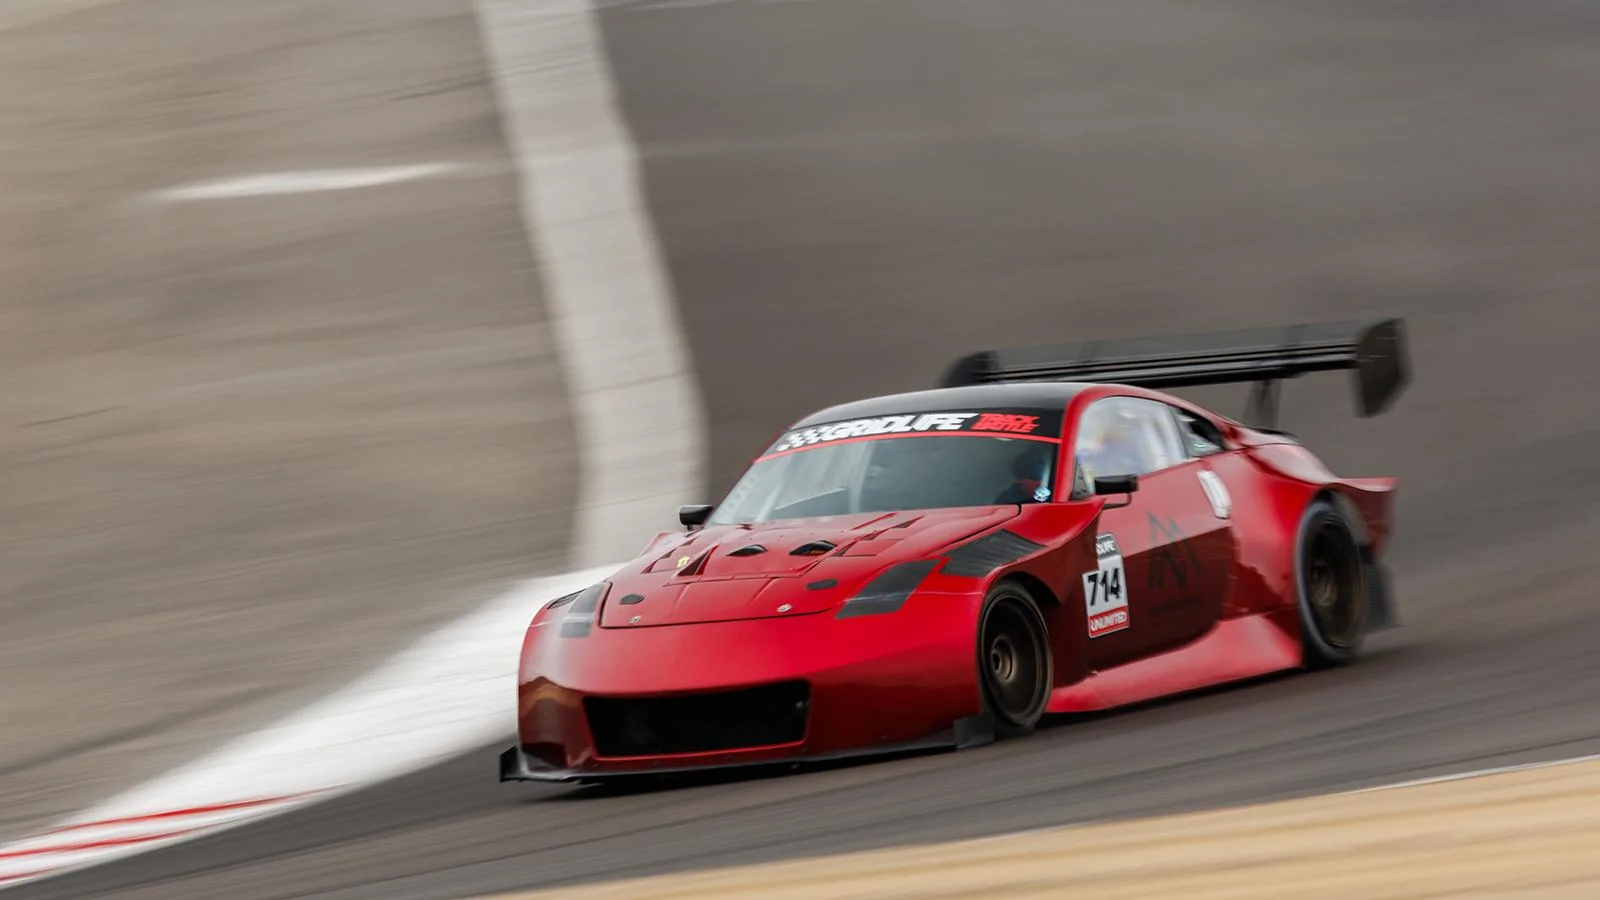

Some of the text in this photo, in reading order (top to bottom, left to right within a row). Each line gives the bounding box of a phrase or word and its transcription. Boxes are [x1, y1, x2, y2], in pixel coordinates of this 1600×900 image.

[819, 413, 978, 441] GRIDLIFE
[971, 421, 1039, 433] BATTLE
[977, 413, 1040, 424] TRACK
[1088, 568, 1121, 606] 714
[1090, 611, 1127, 631] UNLIMITED
